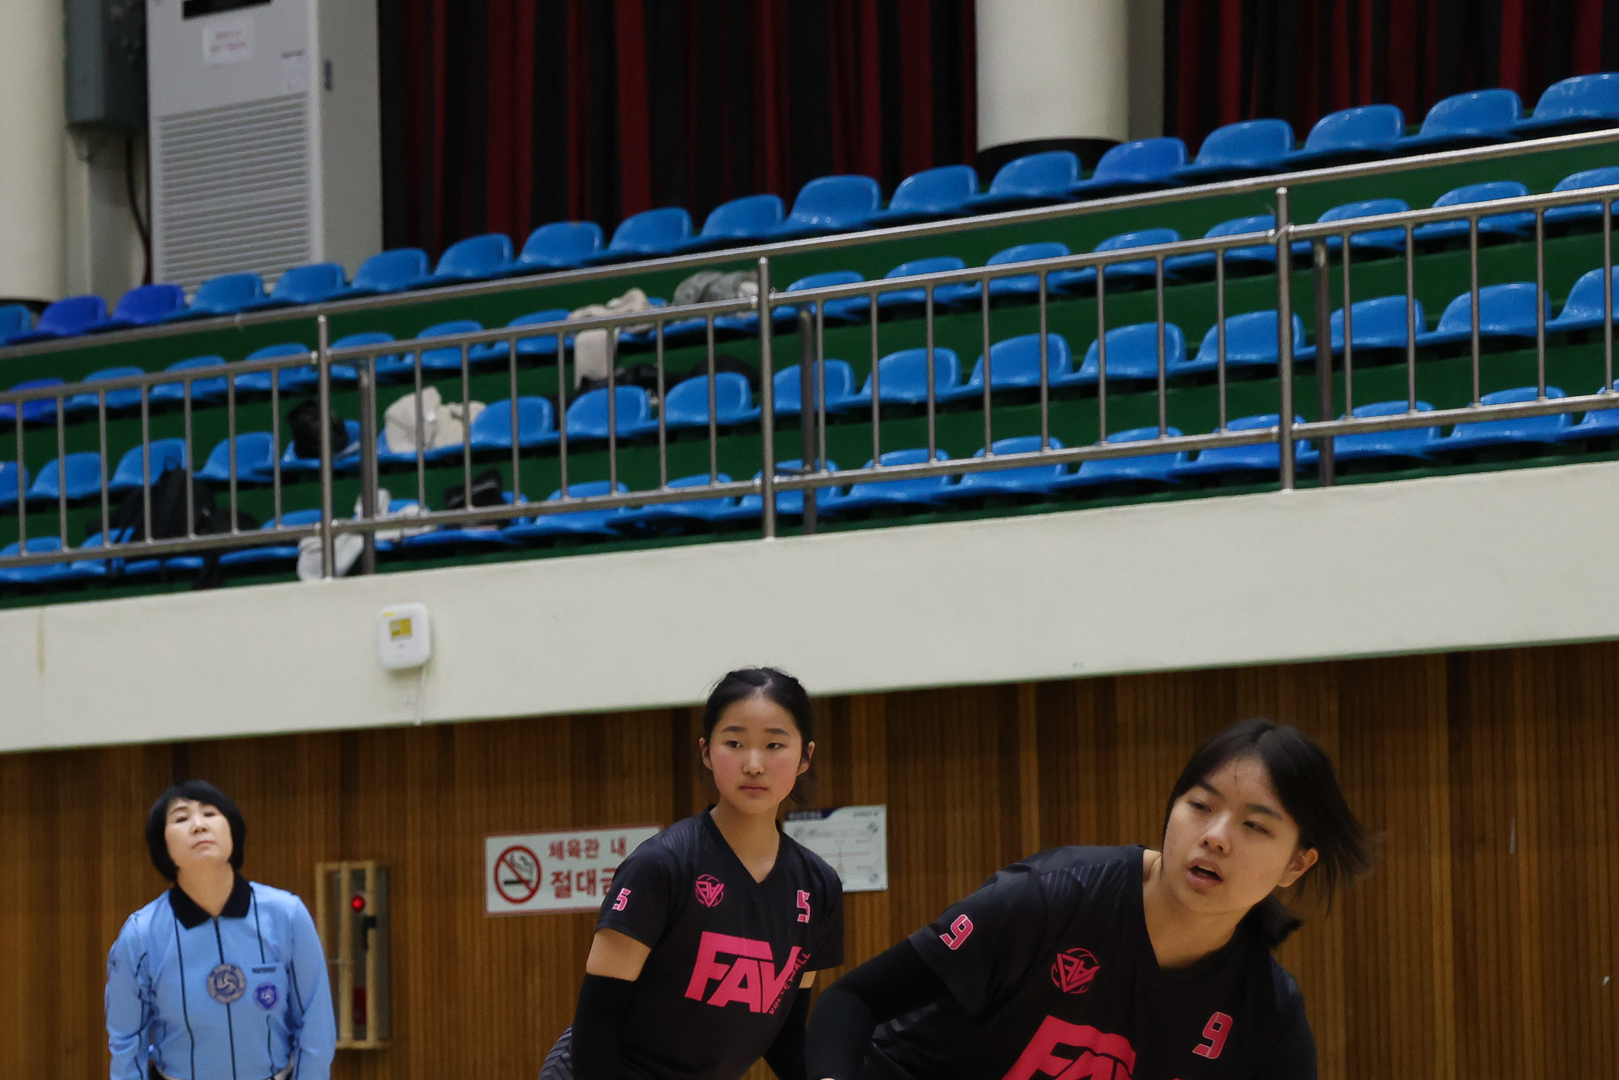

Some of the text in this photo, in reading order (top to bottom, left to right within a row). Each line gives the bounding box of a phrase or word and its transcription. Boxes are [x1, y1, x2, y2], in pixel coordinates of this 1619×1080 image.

[548, 836, 627, 860] 체육관 내
[612, 888, 632, 912] 5
[796, 889, 811, 924] 5
[939, 914, 974, 951] 9
[685, 931, 803, 1015] FAV
[1192, 1011, 1234, 1060] 9
